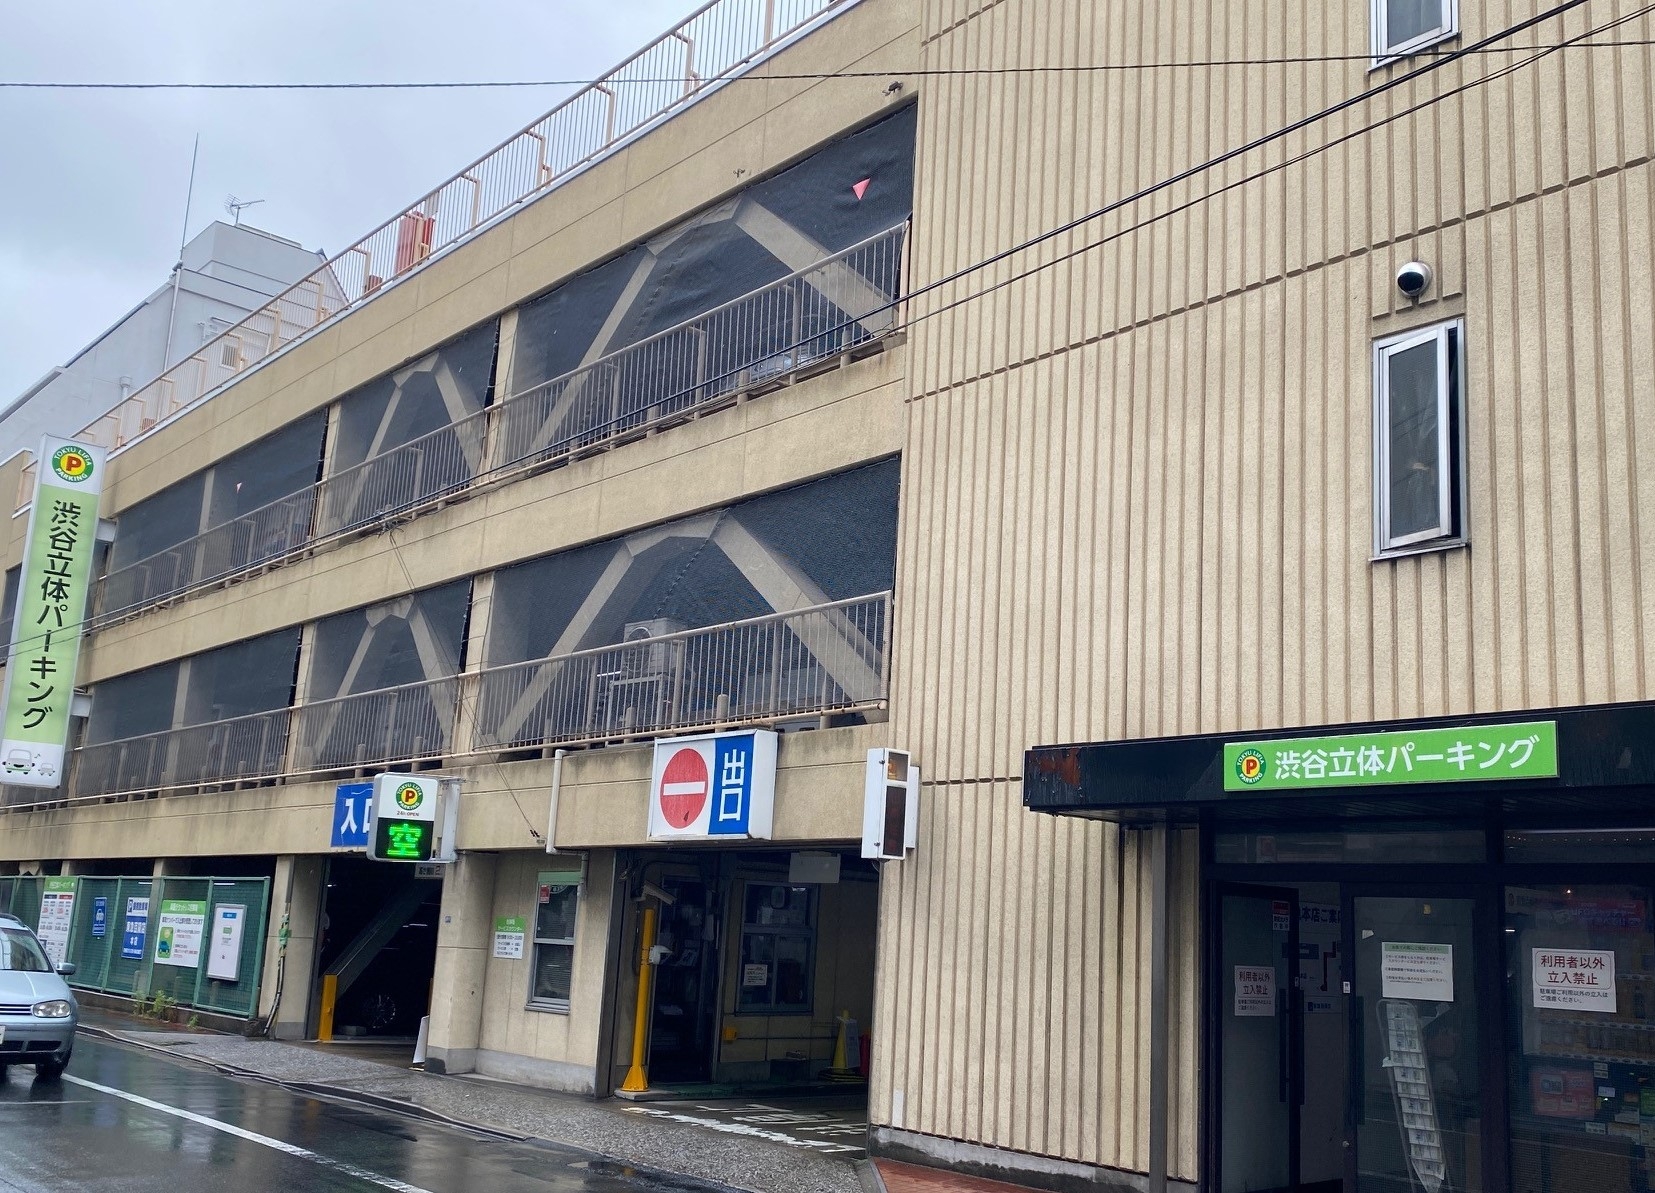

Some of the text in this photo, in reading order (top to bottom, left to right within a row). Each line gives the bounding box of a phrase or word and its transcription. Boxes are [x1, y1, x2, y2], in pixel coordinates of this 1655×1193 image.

[54, 446, 76, 460] TOKYU
[66, 455, 82, 472] P
[55, 467, 88, 482] PARKING
[22, 499, 82, 729] 渋谷立体パーキング
[1237, 750, 1252, 765] TOKYU
[1274, 733, 1541, 780] 渋谷立体パーキング
[1246, 758, 1257, 775] P
[718, 748, 746, 822] 出口
[1239, 772, 1263, 784] PARKING
[405, 790, 416, 803] P
[387, 823, 422, 857] 空
[1301, 905, 1341, 924] 本店ご案
[1540, 955, 1605, 970] 利用者以外
[1239, 971, 1270, 982] 利用者以外
[1547, 971, 1599, 986] 立入禁止
[1243, 985, 1268, 995] 立入禁止
